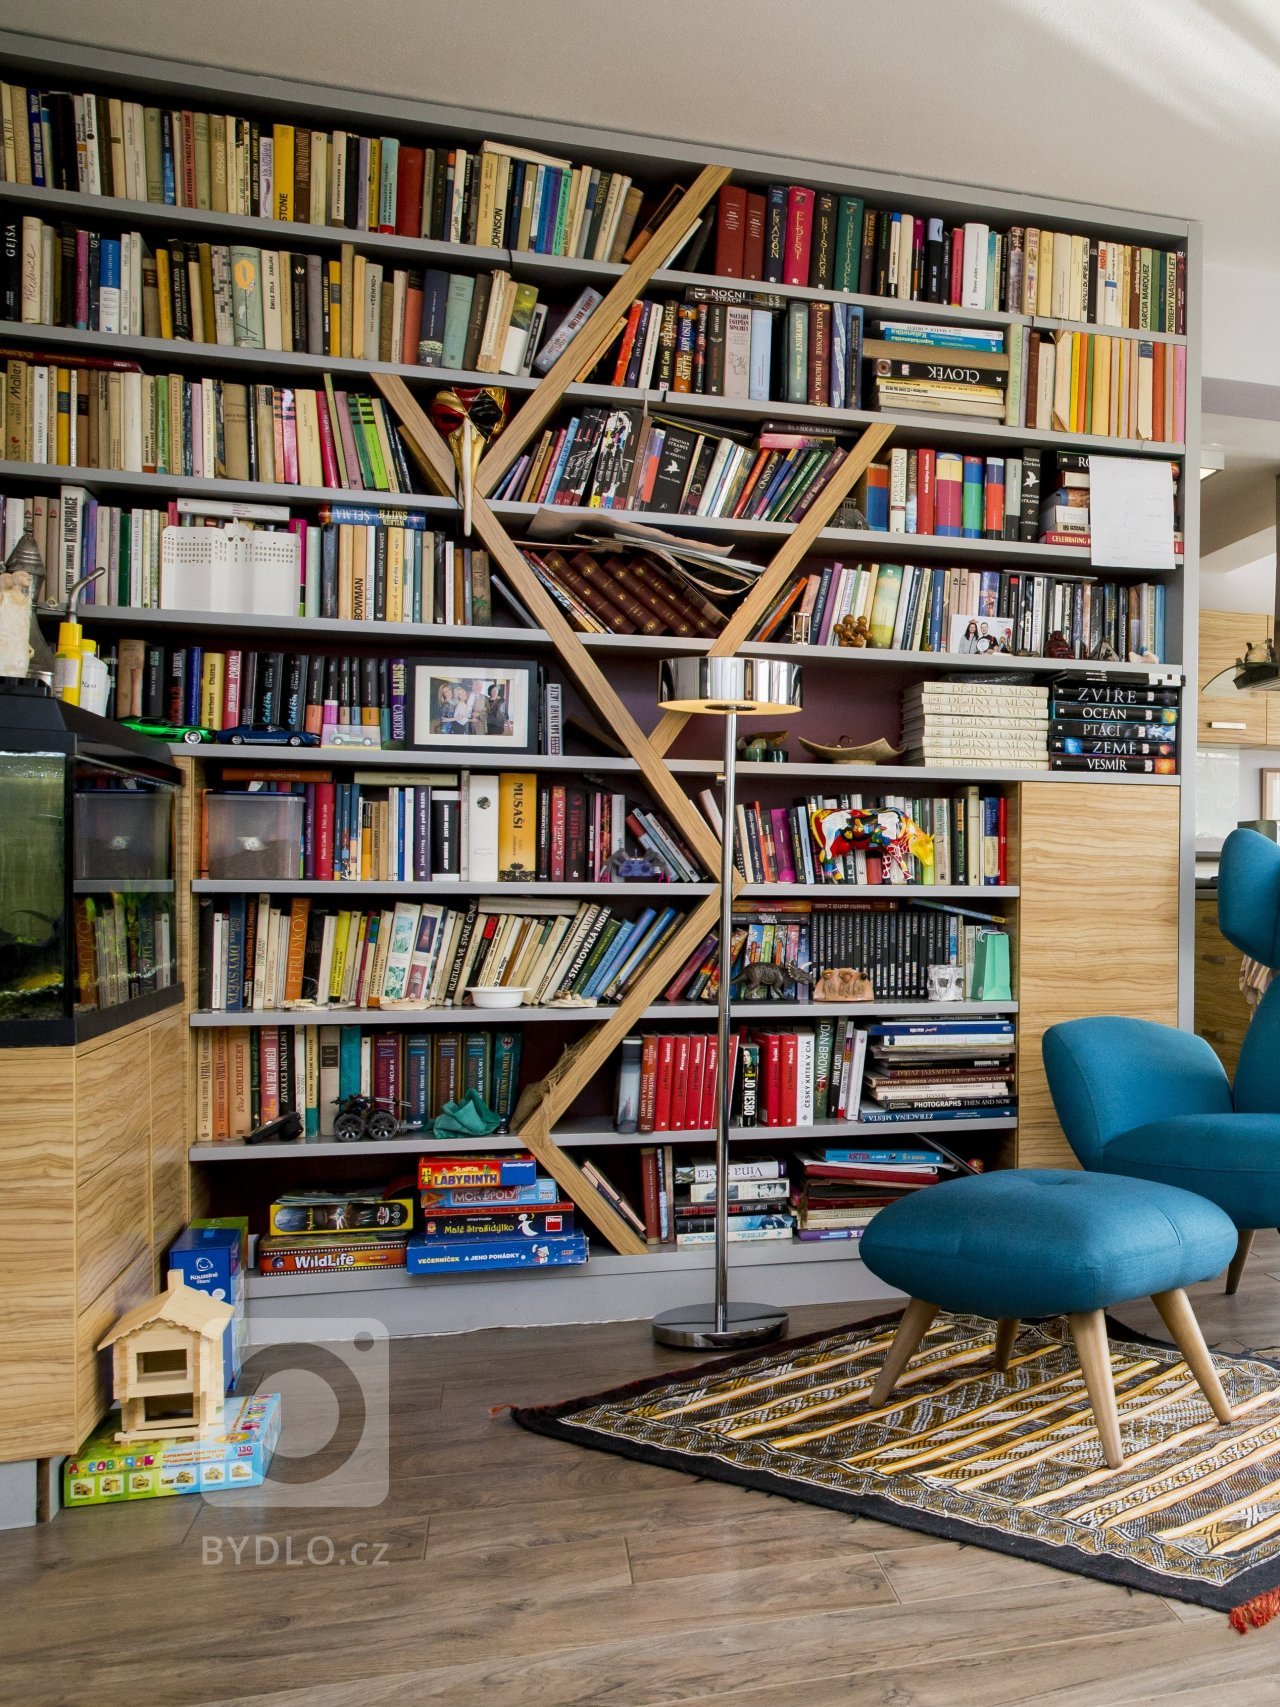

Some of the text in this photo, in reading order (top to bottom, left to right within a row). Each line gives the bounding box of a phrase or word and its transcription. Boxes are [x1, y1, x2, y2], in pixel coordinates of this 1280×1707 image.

[279, 193, 287, 221] STONE
[491, 208, 503, 248] JOHNSON
[5, 225, 16, 256] GEJŠA
[663, 306, 675, 346] SPECIALISTA
[795, 313, 803, 352] LABYRINT
[660, 366, 669, 379] Tom
[682, 355, 691, 380] SMITH
[928, 366, 979, 384] ČLOVĚK
[64, 496, 77, 543] KONSPIRACE
[1052, 536, 1086, 544] CELEBRATING
[65, 544, 75, 570] SUMMERS
[354, 578, 363, 620] BOWMAN
[229, 656, 239, 678] POROTA
[393, 664, 404, 695] SMITH
[1078, 688, 1137, 704] ZVÍŘE
[1083, 708, 1127, 720] OCEÁN
[1083, 723, 1120, 737] PTÁCI
[1093, 741, 1136, 754] ZEMĚ
[1087, 759, 1127, 771] VESMÍR
[512, 783, 525, 829] MUSAŠI
[246, 926, 254, 939] byl
[459, 925, 472, 946] STARÉ
[568, 907, 611, 978] STAROVĚKÁ INDIE
[245, 941, 253, 969] počátku
[455, 947, 464, 957] VE
[227, 945, 240, 1004] DIVY SVĚTA
[244, 971, 251, 980] Na
[448, 959, 462, 991] KULTURA
[816, 1024, 831, 1081] DAN BROWN
[201, 1061, 211, 1080] AFRIKA
[236, 1043, 244, 1096] KORDILLERY
[265, 1048, 277, 1094] RÁJ BEZ ANDĚLŮ
[832, 1070, 841, 1085] JOHN
[745, 1077, 755, 1088] JO
[914, 1100, 962, 1108] PHOTOGRAPHS
[868, 1113, 933, 1122] ZTRACENÁ MĚSTA
[848, 1151, 870, 1160] KRTEK
[434, 1173, 498, 1186] LABYRINTH
[731, 1166, 762, 1178] Vína
[452, 1188, 520, 1202] MONOPOLY
[445, 1223, 465, 1234] Malé
[295, 1254, 354, 1269] WildLife
[418, 1255, 460, 1264] VEČERNÍČEK
[488, 1252, 520, 1260] POHÁDKY
[190, 1272, 218, 1280] Kouzelné
